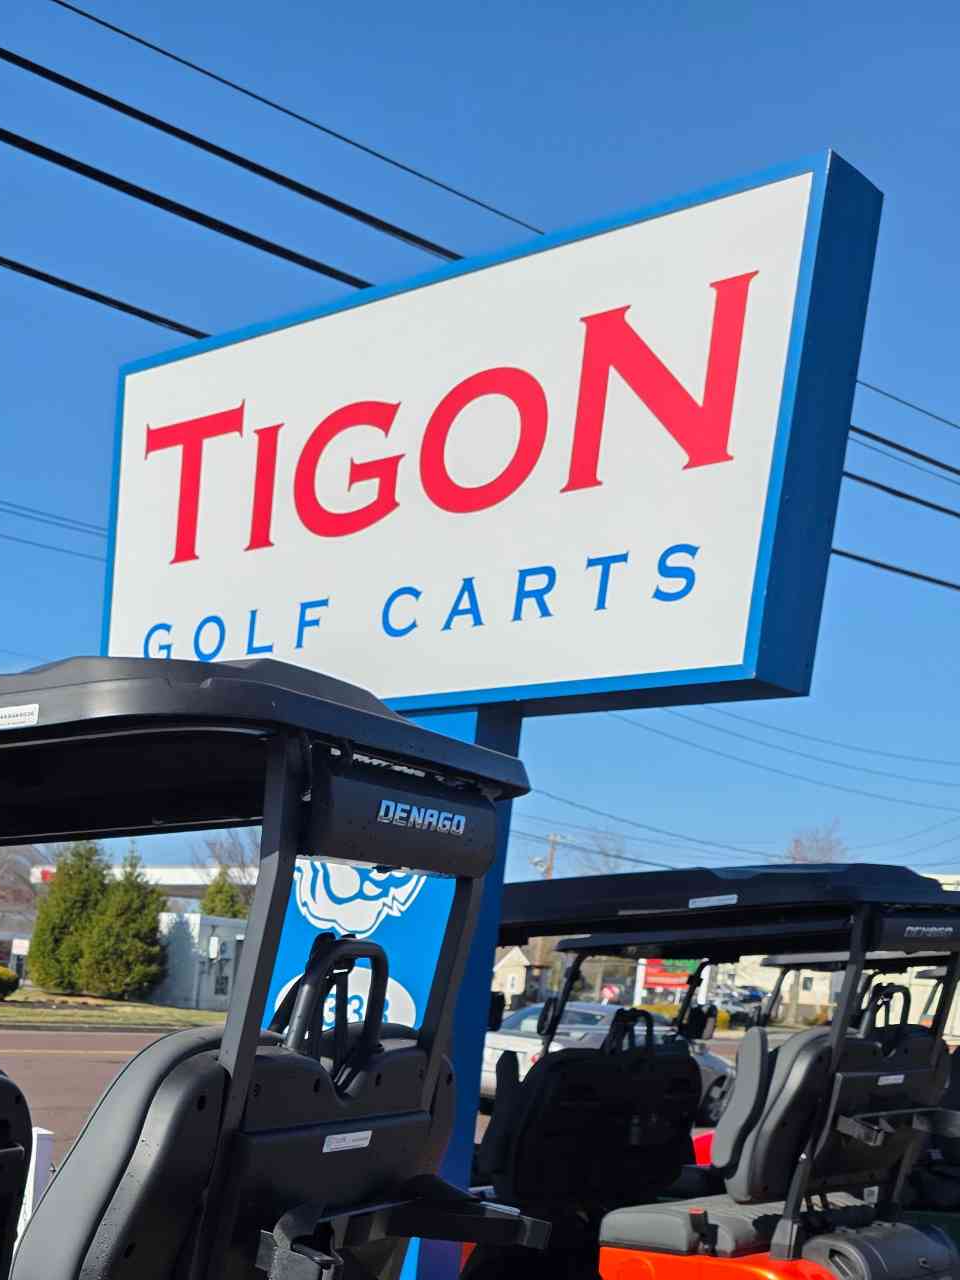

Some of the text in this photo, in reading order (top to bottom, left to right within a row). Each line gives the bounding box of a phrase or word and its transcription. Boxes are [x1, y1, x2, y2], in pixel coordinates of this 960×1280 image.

[145, 271, 758, 564] TIGON
[143, 544, 700, 662] GOLF CARTS
[377, 800, 466, 836] DENAGO
